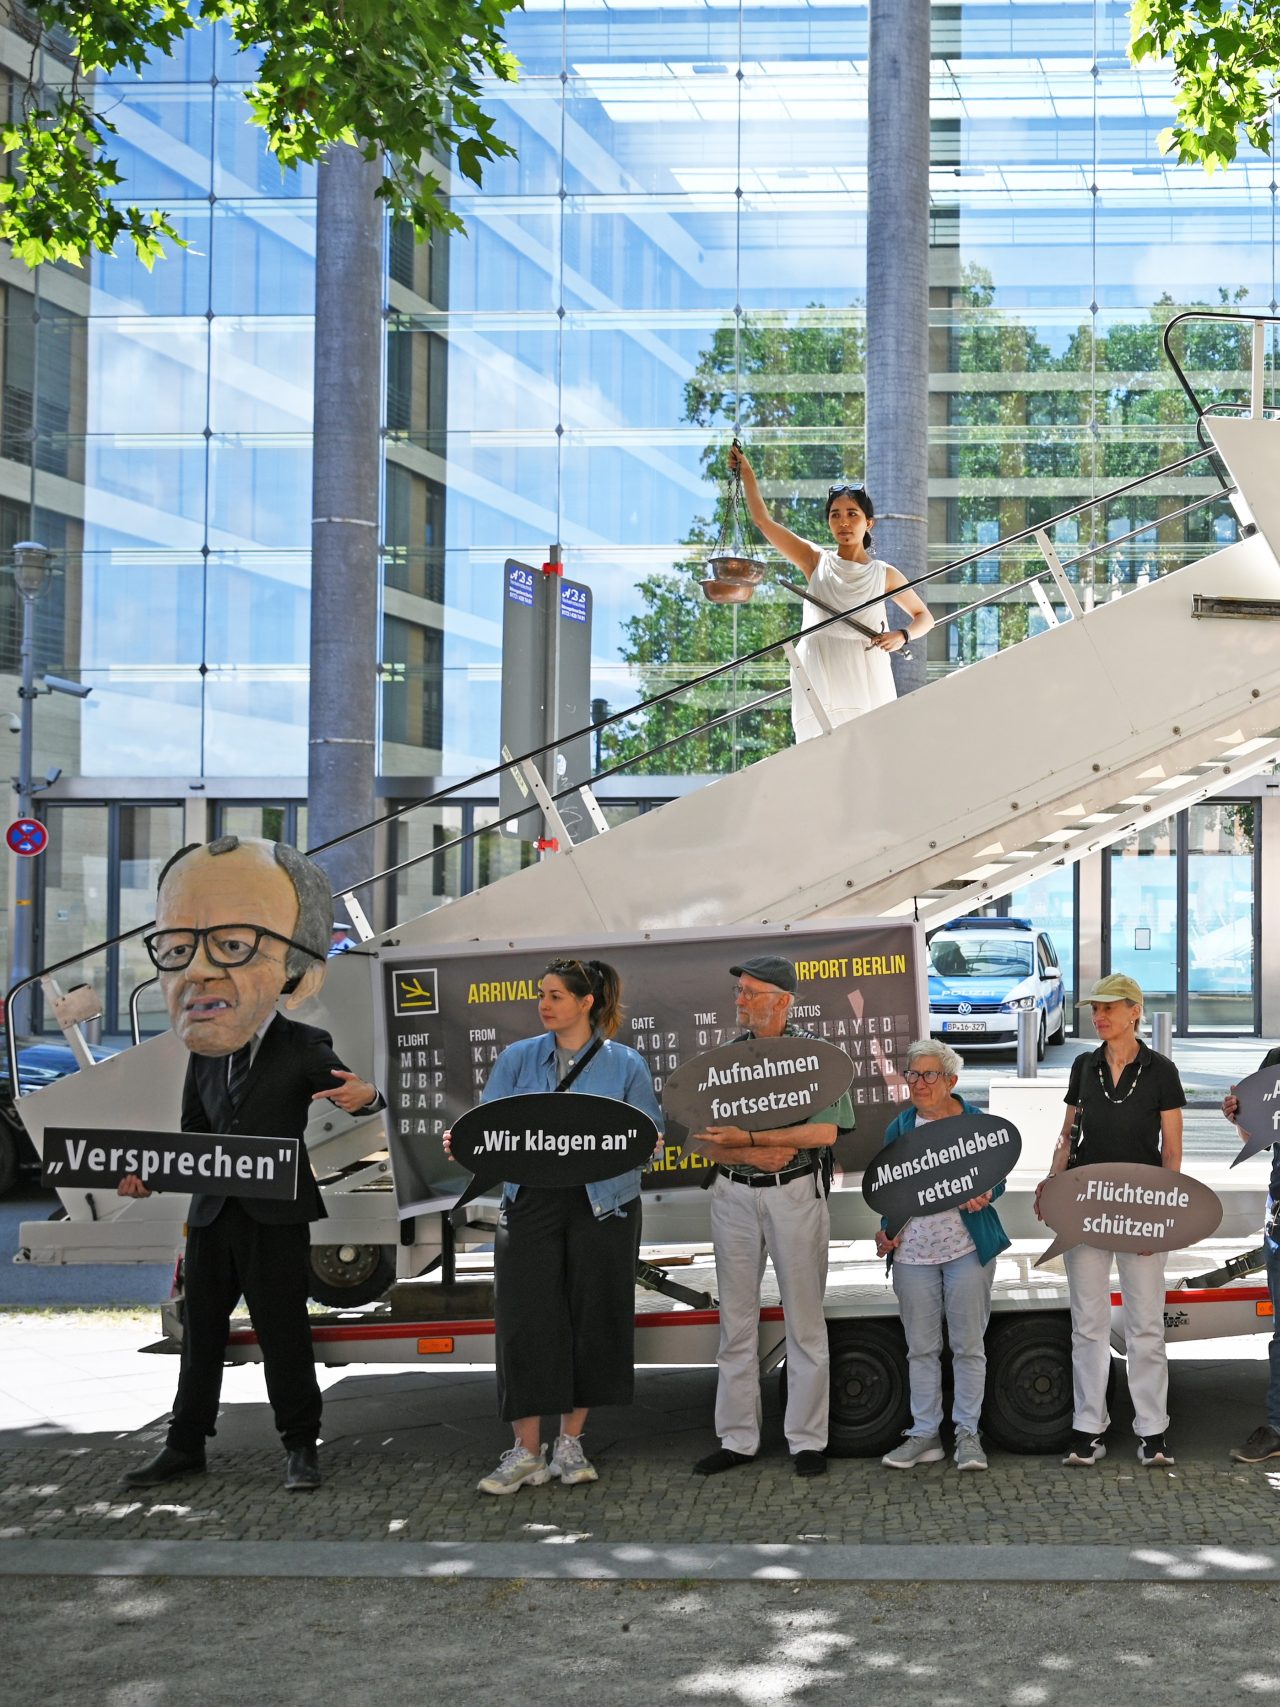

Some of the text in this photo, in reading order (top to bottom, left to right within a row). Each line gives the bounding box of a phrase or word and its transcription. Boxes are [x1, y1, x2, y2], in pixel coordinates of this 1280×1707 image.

[852, 954, 906, 978] BERLIN
[631, 1016, 655, 1030] GATE
[694, 1012, 718, 1026] TIME
[787, 1004, 821, 1020] STATUS
[397, 1032, 430, 1047] FLIGHT
[469, 1028, 497, 1042] FROM
[698, 1055, 820, 1093] „Aufnahmen
[710, 1083, 819, 1120] fortsetzen"
[473, 1129, 638, 1156] „Wir klagen an"
[871, 1126, 1010, 1192] „Menschenleben
[917, 1167, 979, 1207] retten"
[1076, 1178, 1190, 1209] „Flüchtende
[1082, 1213, 1175, 1239] schützen"
